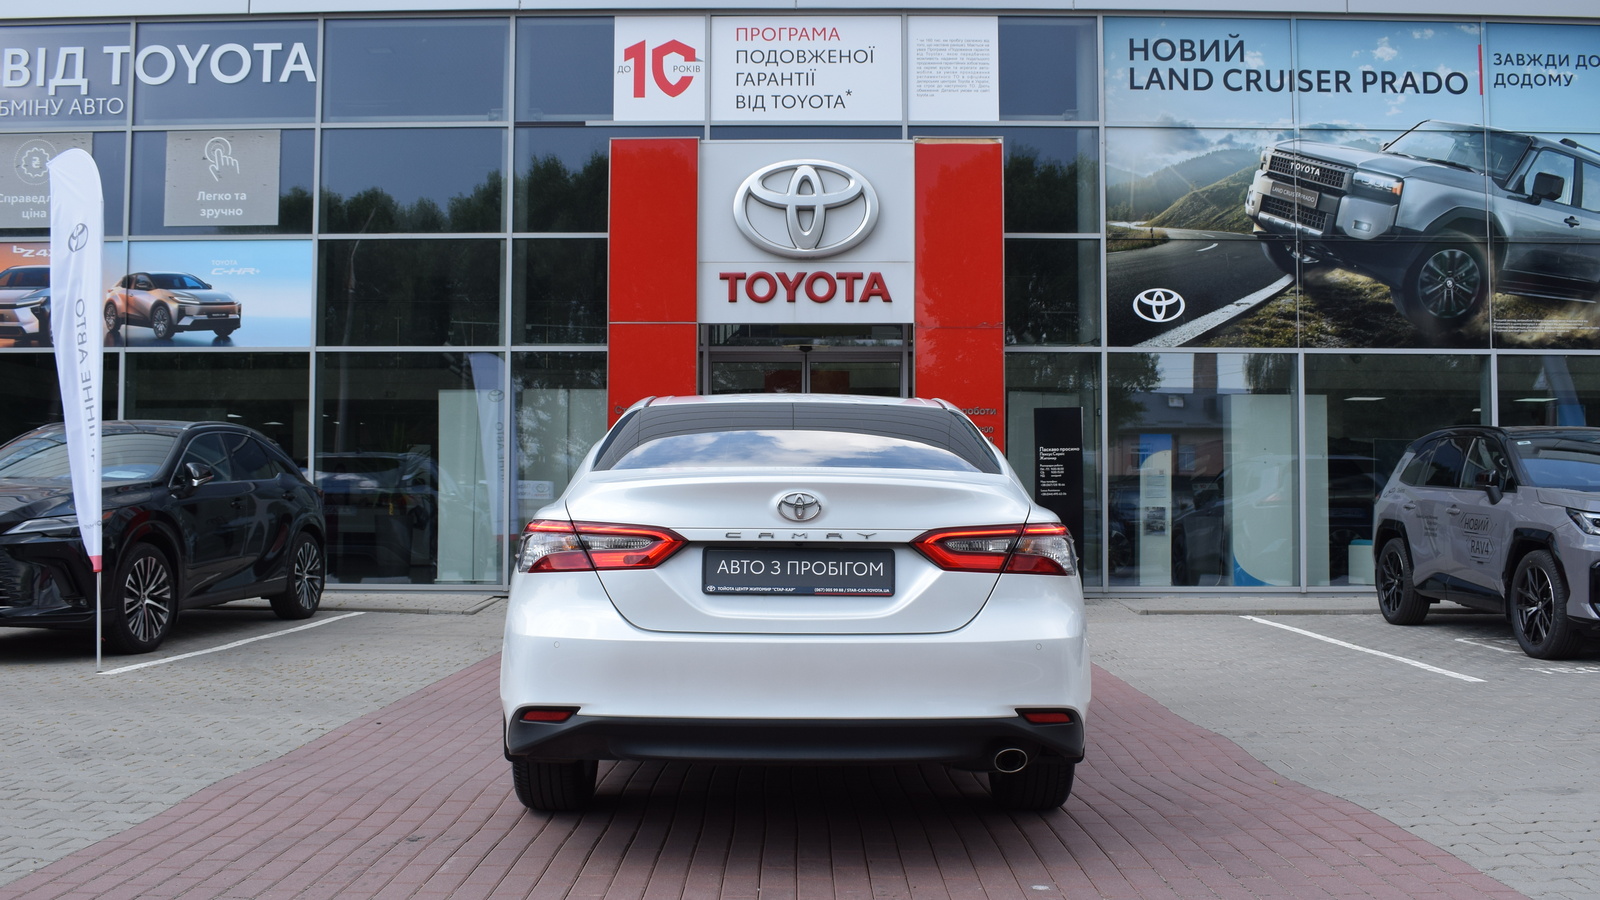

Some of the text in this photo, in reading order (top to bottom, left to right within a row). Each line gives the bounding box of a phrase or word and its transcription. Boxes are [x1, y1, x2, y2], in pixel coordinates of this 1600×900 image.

[736, 27, 840, 42] ПРОГРАМА
[1129, 33, 1245, 63] НОВИЙ
[736, 46, 875, 67] ПОДОВЖЕНОЇ
[1493, 53, 1569, 69] ЗАВЖДИ
[2, 42, 317, 95] ВІД TOYOTA
[617, 65, 631, 74] ДО
[673, 65, 701, 73] РОКІВ
[736, 69, 815, 86] ГАРАНТІЇ
[1129, 67, 1468, 95] LAND CRUISER PRADO
[1493, 73, 1574, 89] ДОДОМУ
[69, 97, 124, 115] АВТО
[736, 94, 766, 112] ВІД
[1290, 162, 1320, 176] TOYOTA
[197, 191, 247, 201] Легко та
[22, 208, 47, 220] ціна
[200, 206, 243, 218] зручно
[719, 271, 892, 303] TOYOTA
[1464, 517, 1489, 531] НОВИЙ
[725, 532, 877, 540] CAMRY
[1470, 540, 1489, 555] RAV4
[716, 560, 884, 576] АВТО З ПРОБІГОМ
